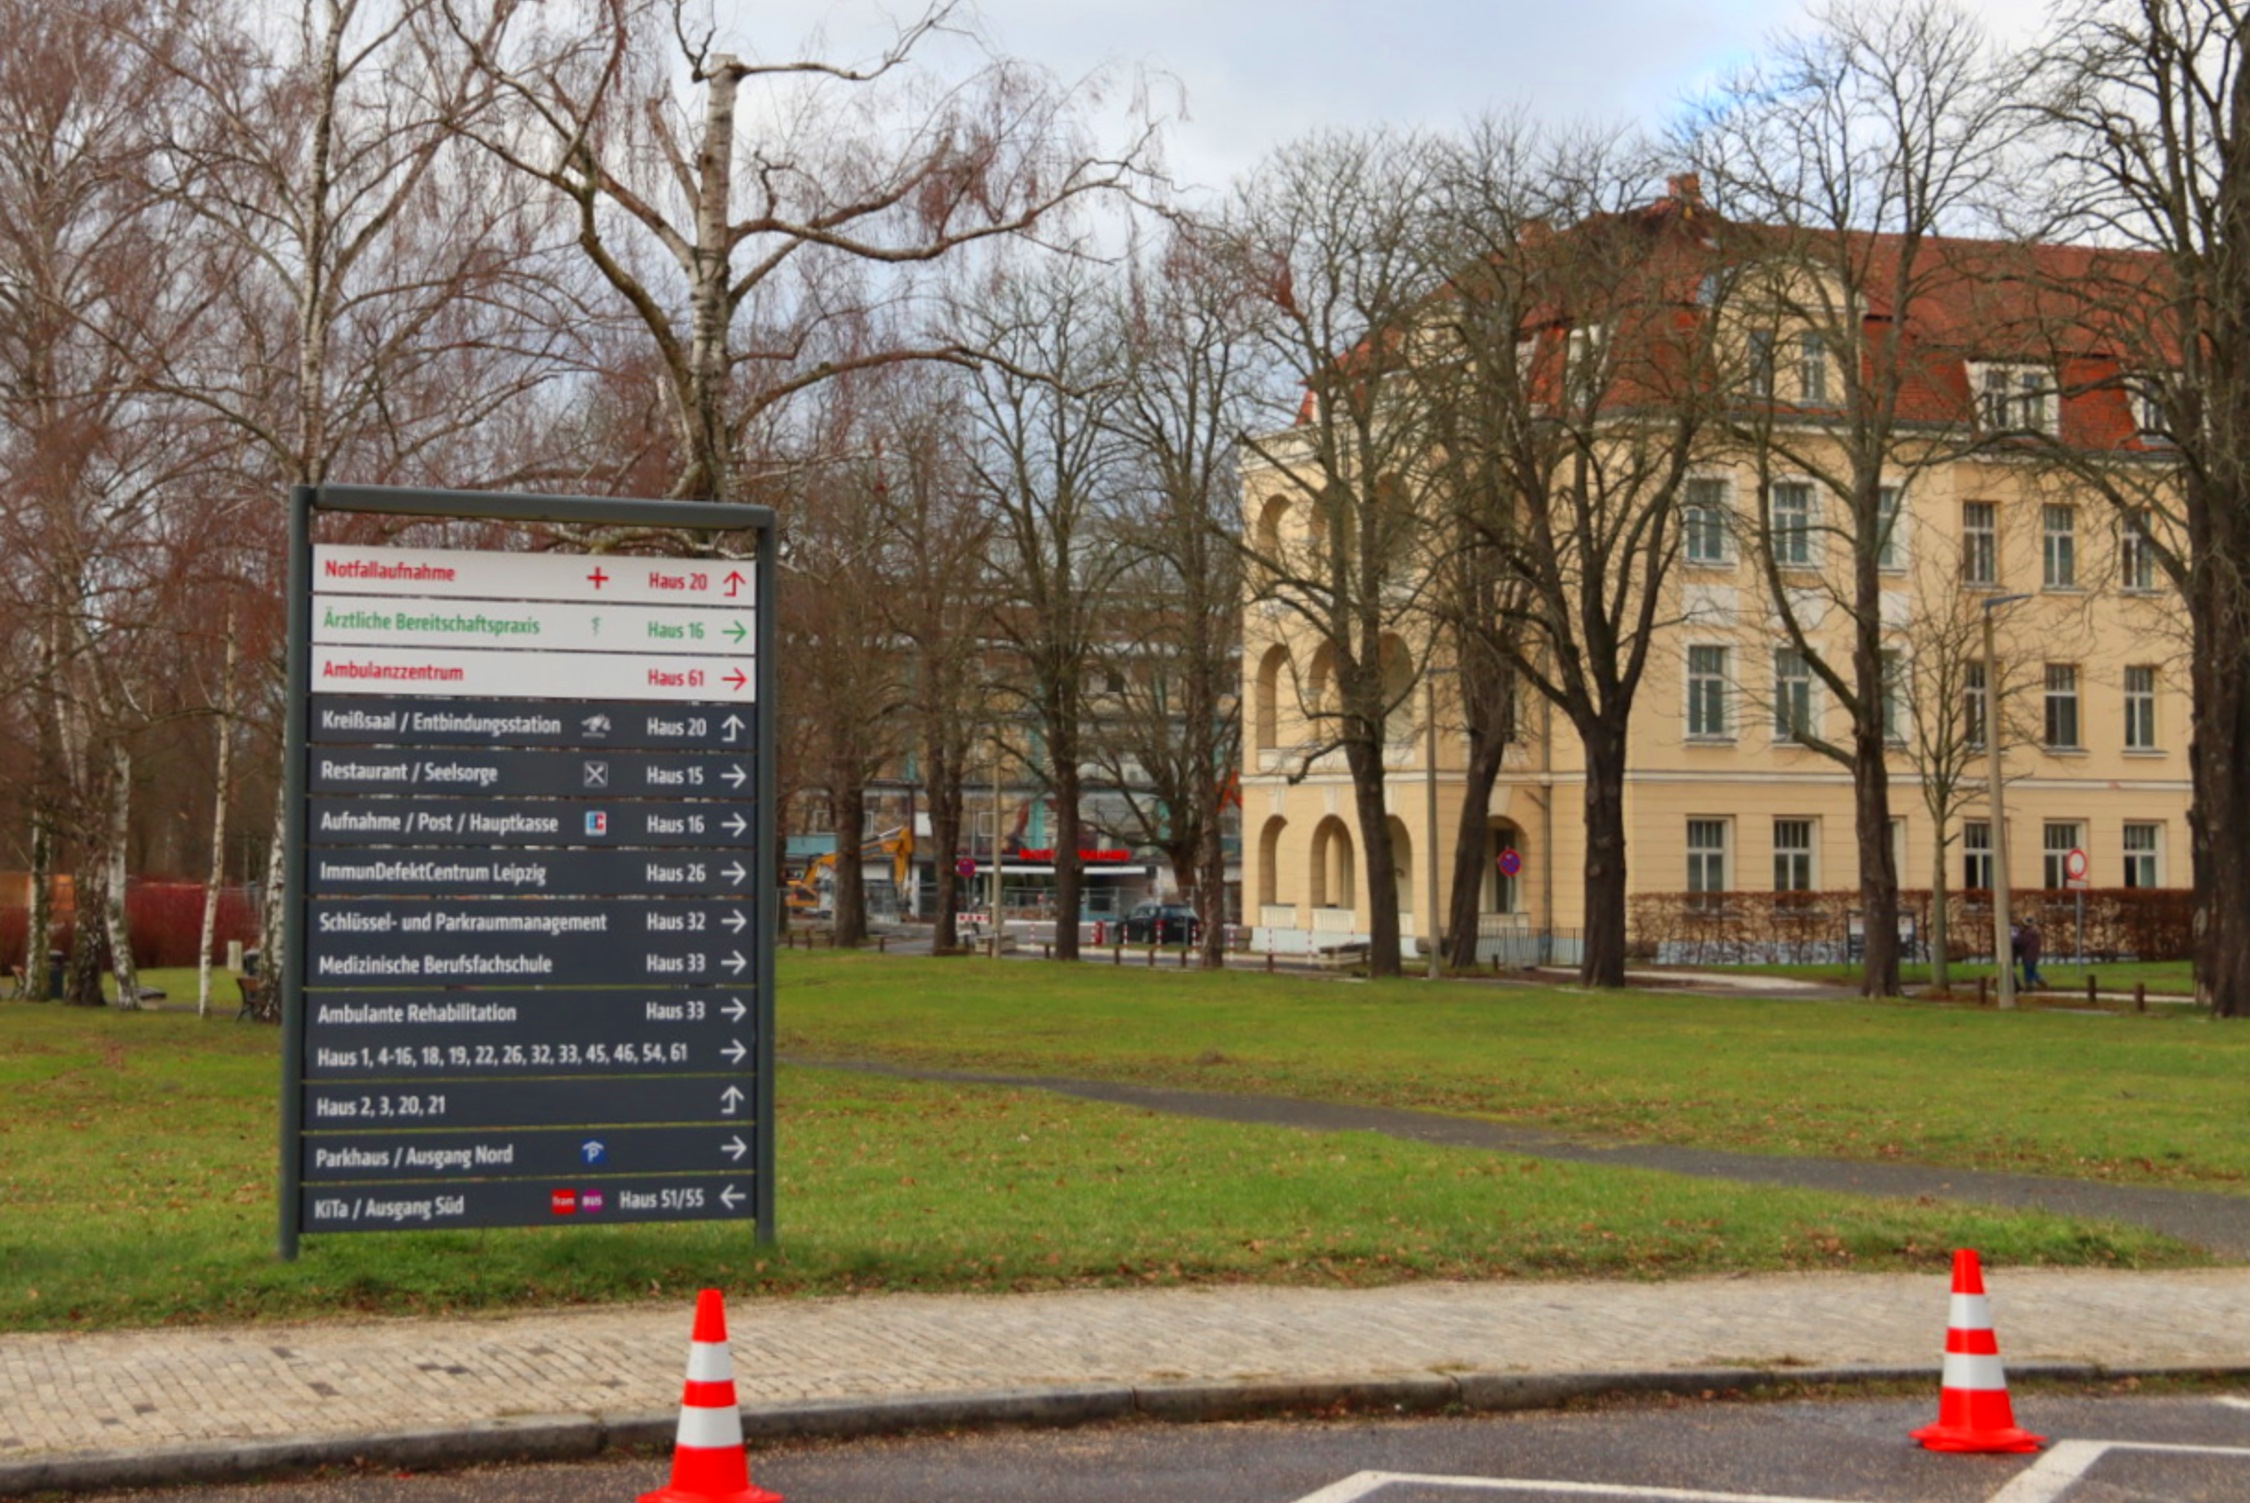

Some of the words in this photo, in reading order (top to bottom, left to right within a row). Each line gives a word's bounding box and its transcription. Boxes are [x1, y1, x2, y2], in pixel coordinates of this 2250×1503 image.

[324, 560, 456, 580] Notfallaufnahme
[649, 573, 685, 590] Haus
[689, 573, 708, 590] 20
[323, 608, 392, 631] Ärztliche
[395, 613, 540, 635] Bereitschaftspraxis
[648, 624, 684, 639] Haus
[688, 622, 704, 639] 16
[323, 661, 464, 680] Ambulanzzentrum
[648, 671, 684, 686] Haus
[688, 670, 705, 687] 61
[322, 710, 396, 730] Kreißsaal
[400, 712, 409, 733] /
[413, 712, 561, 737] Entbindungsstation
[648, 718, 684, 736] Haus
[688, 718, 706, 736] 20
[321, 760, 408, 780] Restaurant
[412, 762, 420, 783] /
[425, 762, 498, 786] Seelsorge
[648, 766, 684, 784] Haus
[688, 766, 703, 784] 15
[321, 811, 401, 831] Aufnahme
[405, 812, 414, 833] /
[418, 812, 453, 831] Post
[457, 813, 466, 834] /
[470, 813, 558, 836] Hauptkasse
[648, 815, 684, 833] Haus
[688, 815, 704, 833] 16
[320, 861, 489, 881] ImmunDefektCentrum
[493, 863, 546, 886] Leipzig
[648, 864, 684, 882] Haus
[688, 864, 706, 882] 26
[320, 912, 397, 931] Schlüssel-
[402, 912, 431, 931] und
[435, 912, 607, 935] Parkraummanagement
[648, 912, 684, 930] Haus
[688, 912, 706, 930] 32
[319, 955, 420, 974] Medizinische
[424, 954, 552, 974] Berufsfachschule
[648, 954, 684, 972] Haus
[688, 953, 706, 972] 33
[318, 1004, 403, 1023] Ambulante
[407, 1003, 516, 1022] Rehabilitation
[647, 1002, 683, 1020] Haus
[687, 1001, 705, 1019] 33
[318, 1048, 357, 1067] Haus
[361, 1048, 373, 1068] 1,
[378, 1047, 417, 1067] 4-16,
[422, 1046, 444, 1066] 18,
[449, 1046, 471, 1066] 19,
[475, 1045, 498, 1066] 22,
[503, 1045, 527, 1065] 26,
[532, 1044, 554, 1065] 32,
[559, 1044, 582, 1064] 33,
[586, 1044, 610, 1064] 45,
[614, 1044, 638, 1063] 46,
[643, 1043, 666, 1063] 54,
[671, 1043, 687, 1061] 61
[317, 1098, 356, 1116] Haus
[360, 1096, 375, 1117] 2,
[380, 1096, 394, 1117] 3,
[398, 1096, 424, 1116] 20,
[428, 1095, 445, 1114] 21
[316, 1148, 389, 1167] Parkhaus
[394, 1147, 403, 1168] /
[406, 1147, 471, 1169] Ausgang
[475, 1144, 513, 1164] Nord
[315, 1199, 348, 1218] KiTa
[352, 1199, 361, 1220] /
[365, 1198, 431, 1221] Ausgang
[435, 1195, 464, 1215] Süd
[620, 1191, 657, 1209] Haus
[661, 1188, 704, 1209] 51/55
